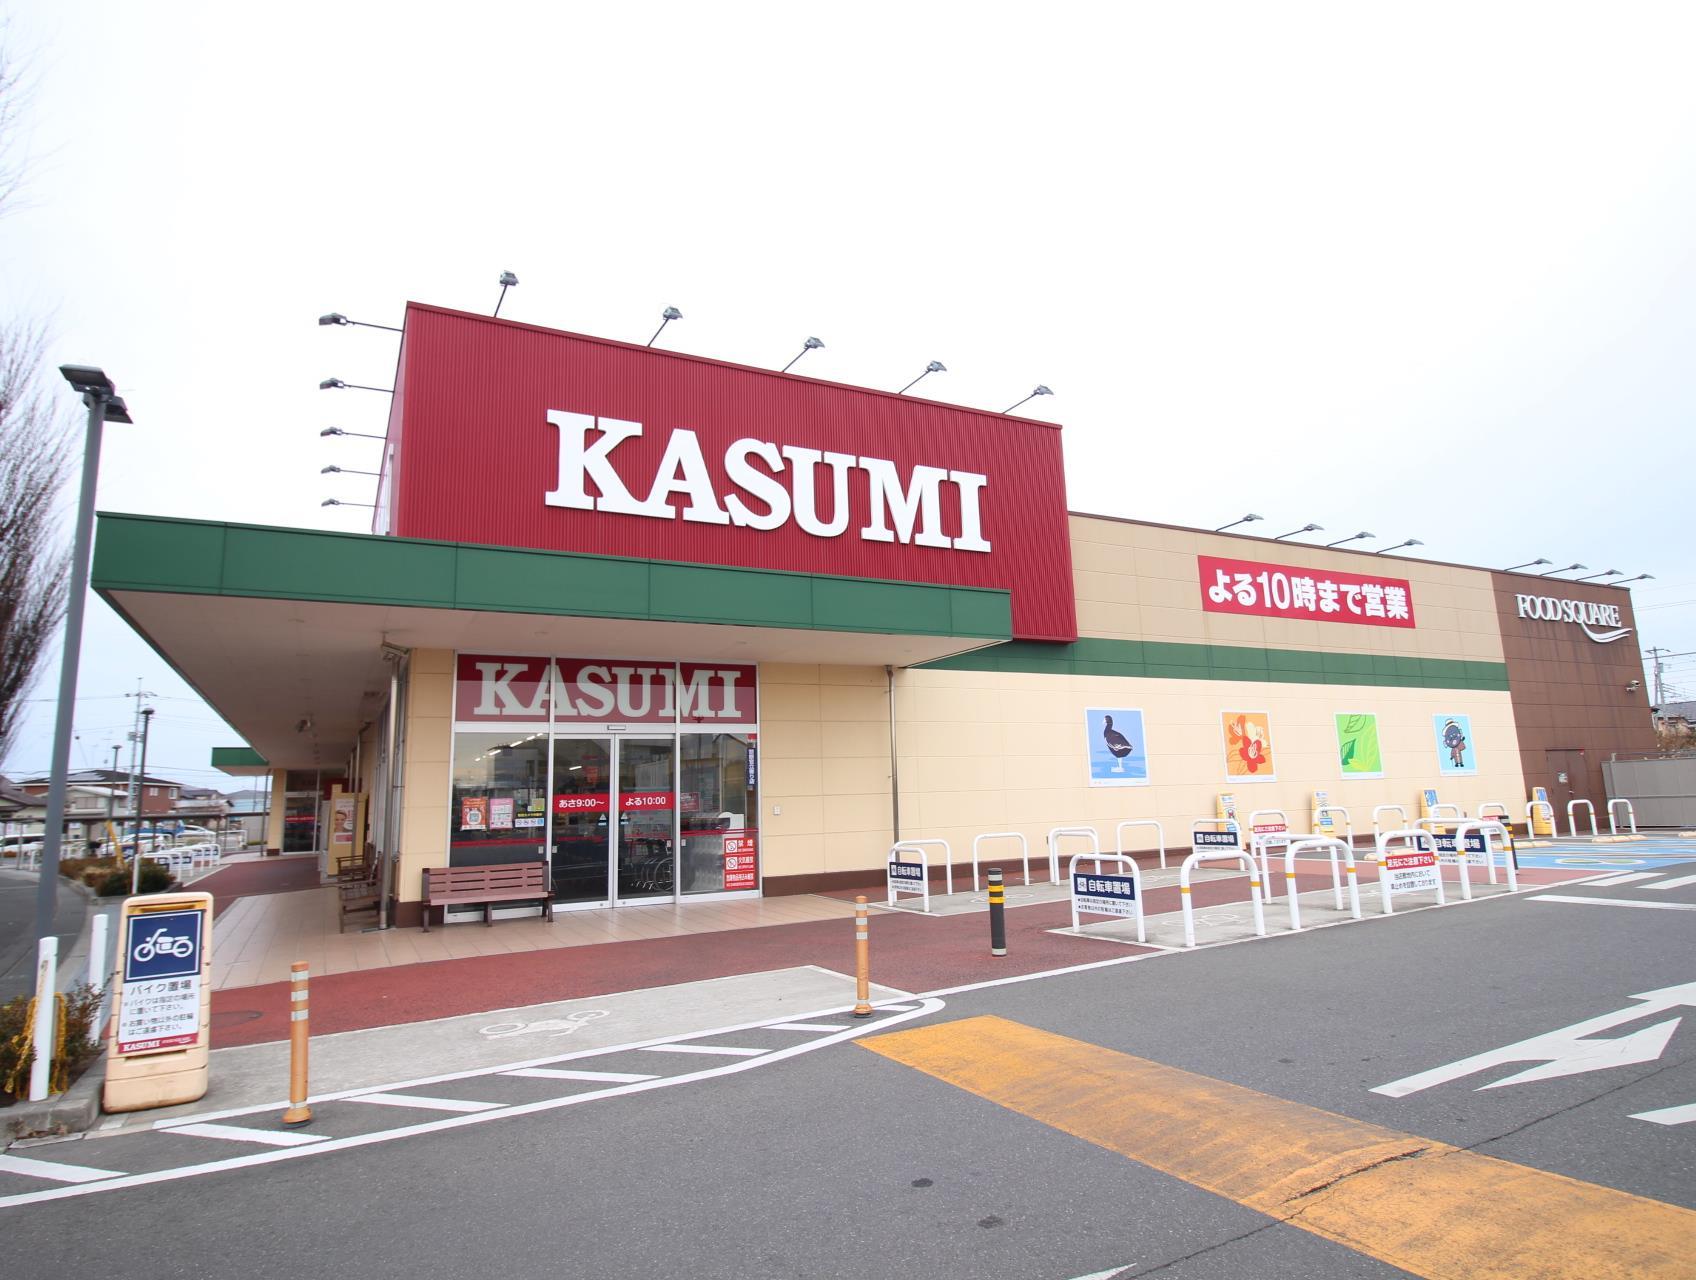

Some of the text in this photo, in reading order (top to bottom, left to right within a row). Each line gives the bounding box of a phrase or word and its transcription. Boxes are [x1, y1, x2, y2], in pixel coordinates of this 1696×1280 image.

[546, 409, 991, 552] KASUMI
[1209, 569, 1409, 620] よる10時まで営業
[1515, 593, 1627, 634] FOOD SQUARE
[474, 662, 742, 717] KASUMI
[625, 797, 666, 806] よる10:00
[1387, 856, 1433, 867] 足元にご注意下さい
[1088, 879, 1131, 895] 自転車置場
[131, 980, 192, 995] バイク置場
[123, 1040, 161, 1052] KASUMI
